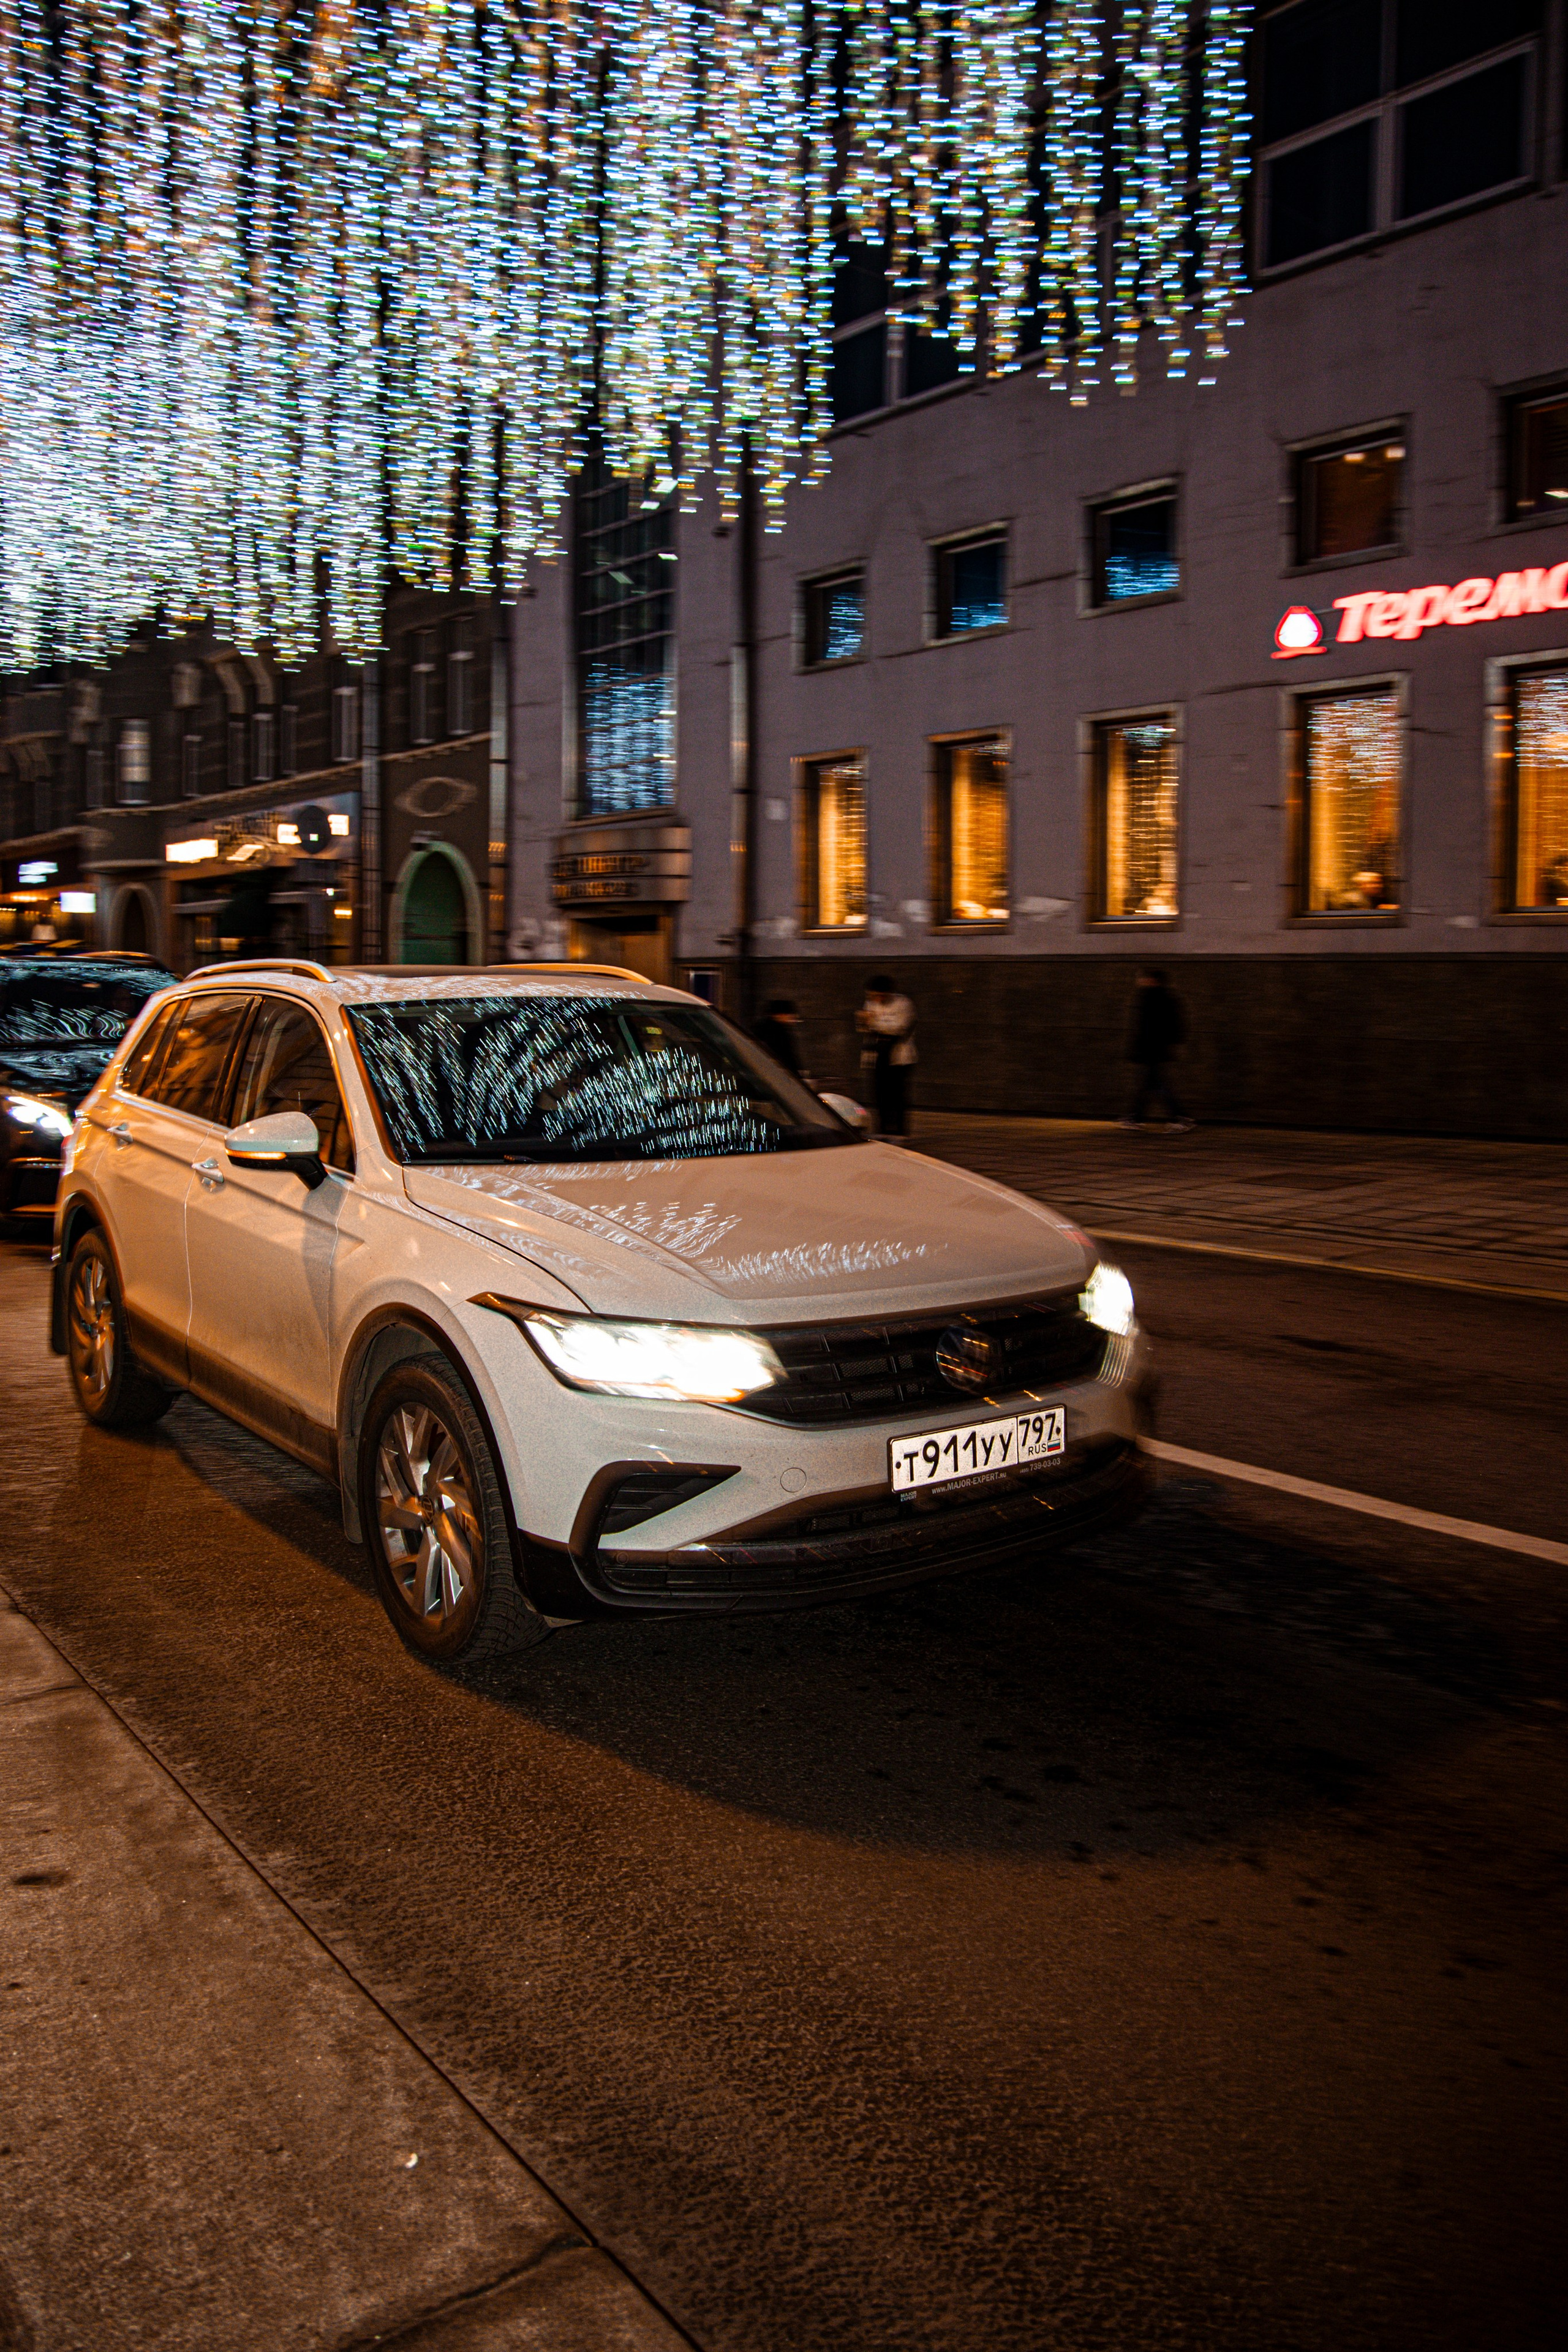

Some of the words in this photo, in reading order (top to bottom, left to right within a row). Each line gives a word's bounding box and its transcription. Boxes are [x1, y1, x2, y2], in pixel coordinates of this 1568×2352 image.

[1019, 1412, 1056, 1447] 797
[1028, 1443, 1047, 1456] RUS
[1030, 1458, 1061, 1471] 739-03-03
